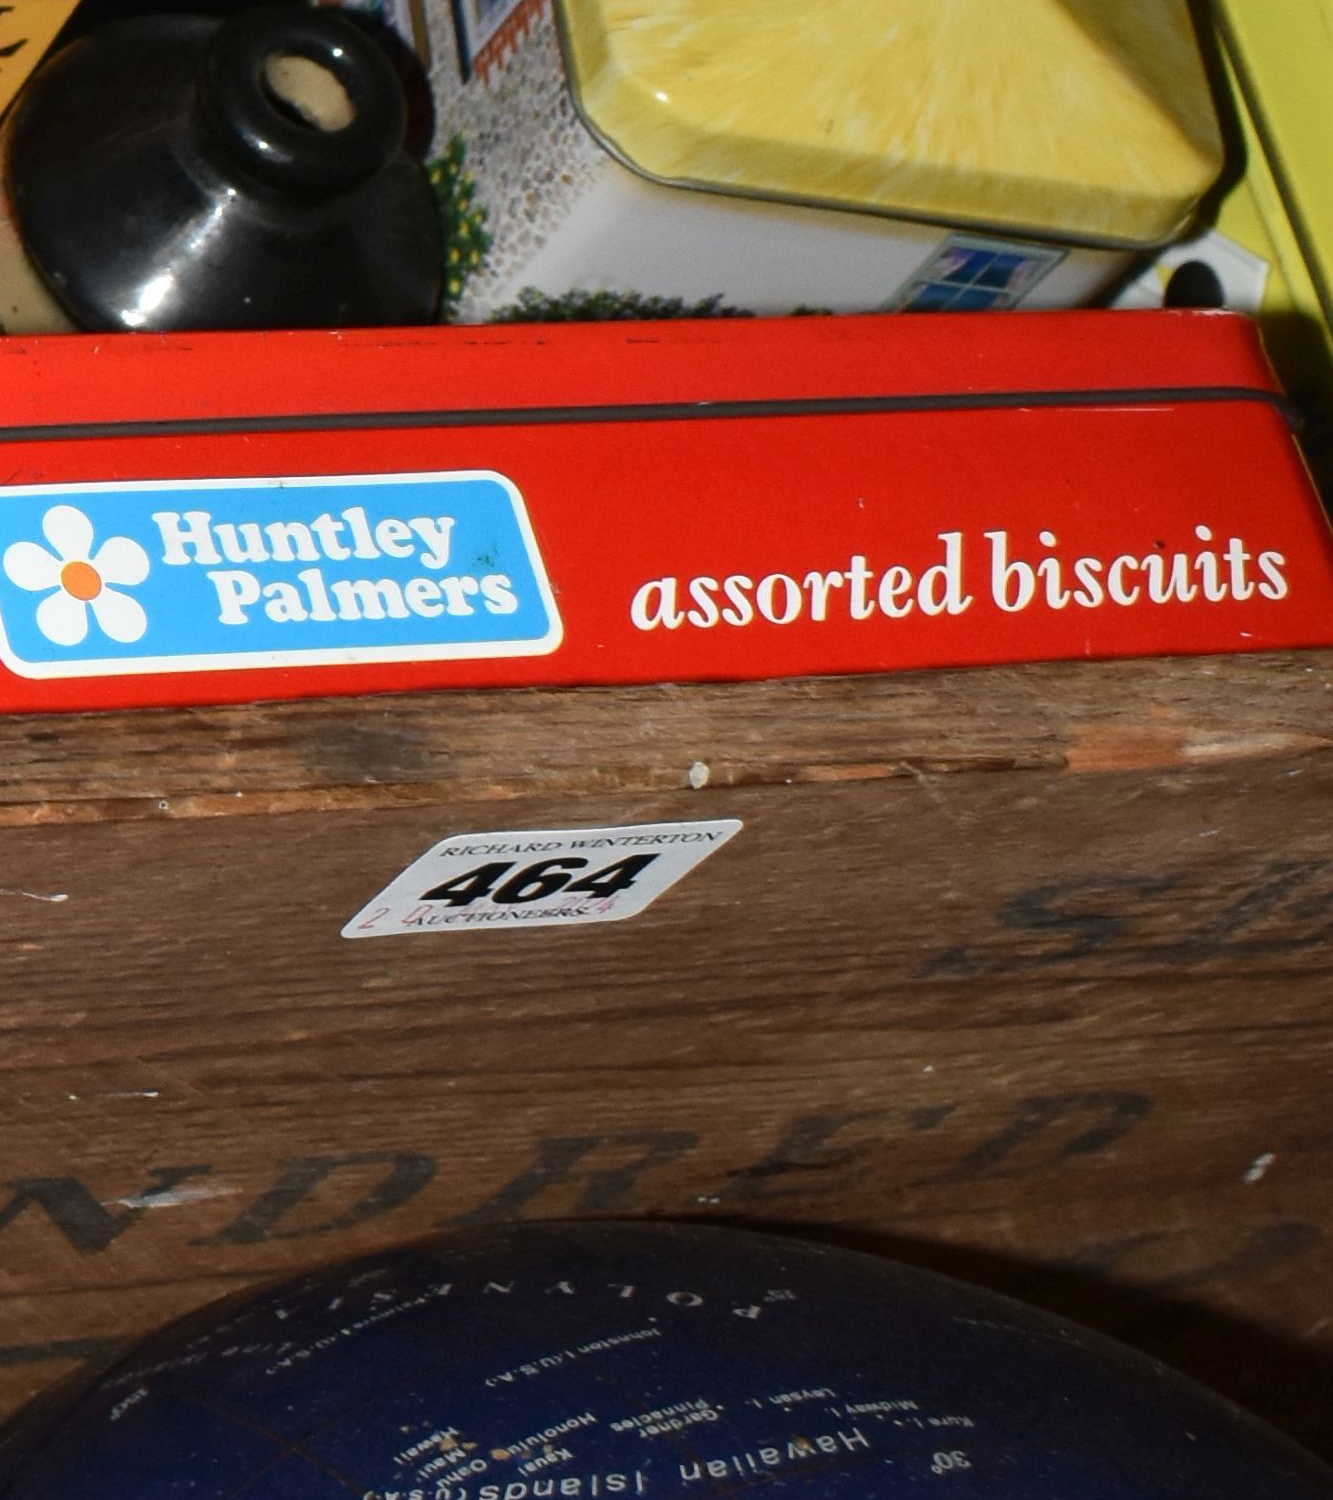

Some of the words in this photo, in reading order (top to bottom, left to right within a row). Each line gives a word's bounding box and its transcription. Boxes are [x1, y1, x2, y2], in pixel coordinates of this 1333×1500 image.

[151, 506, 456, 569] Huntley
[207, 571, 519, 626] Palmers
[631, 530, 973, 631] assorted
[983, 525, 1289, 612] biscuits
[439, 841, 563, 858] RICHARD
[570, 830, 726, 850] WINTERTON
[419, 851, 662, 909] 464
[505, 1411, 597, 1456] Honolulu
[678, 1427, 871, 1481] Hawaiian
[930, 1449, 972, 1475] 30°
